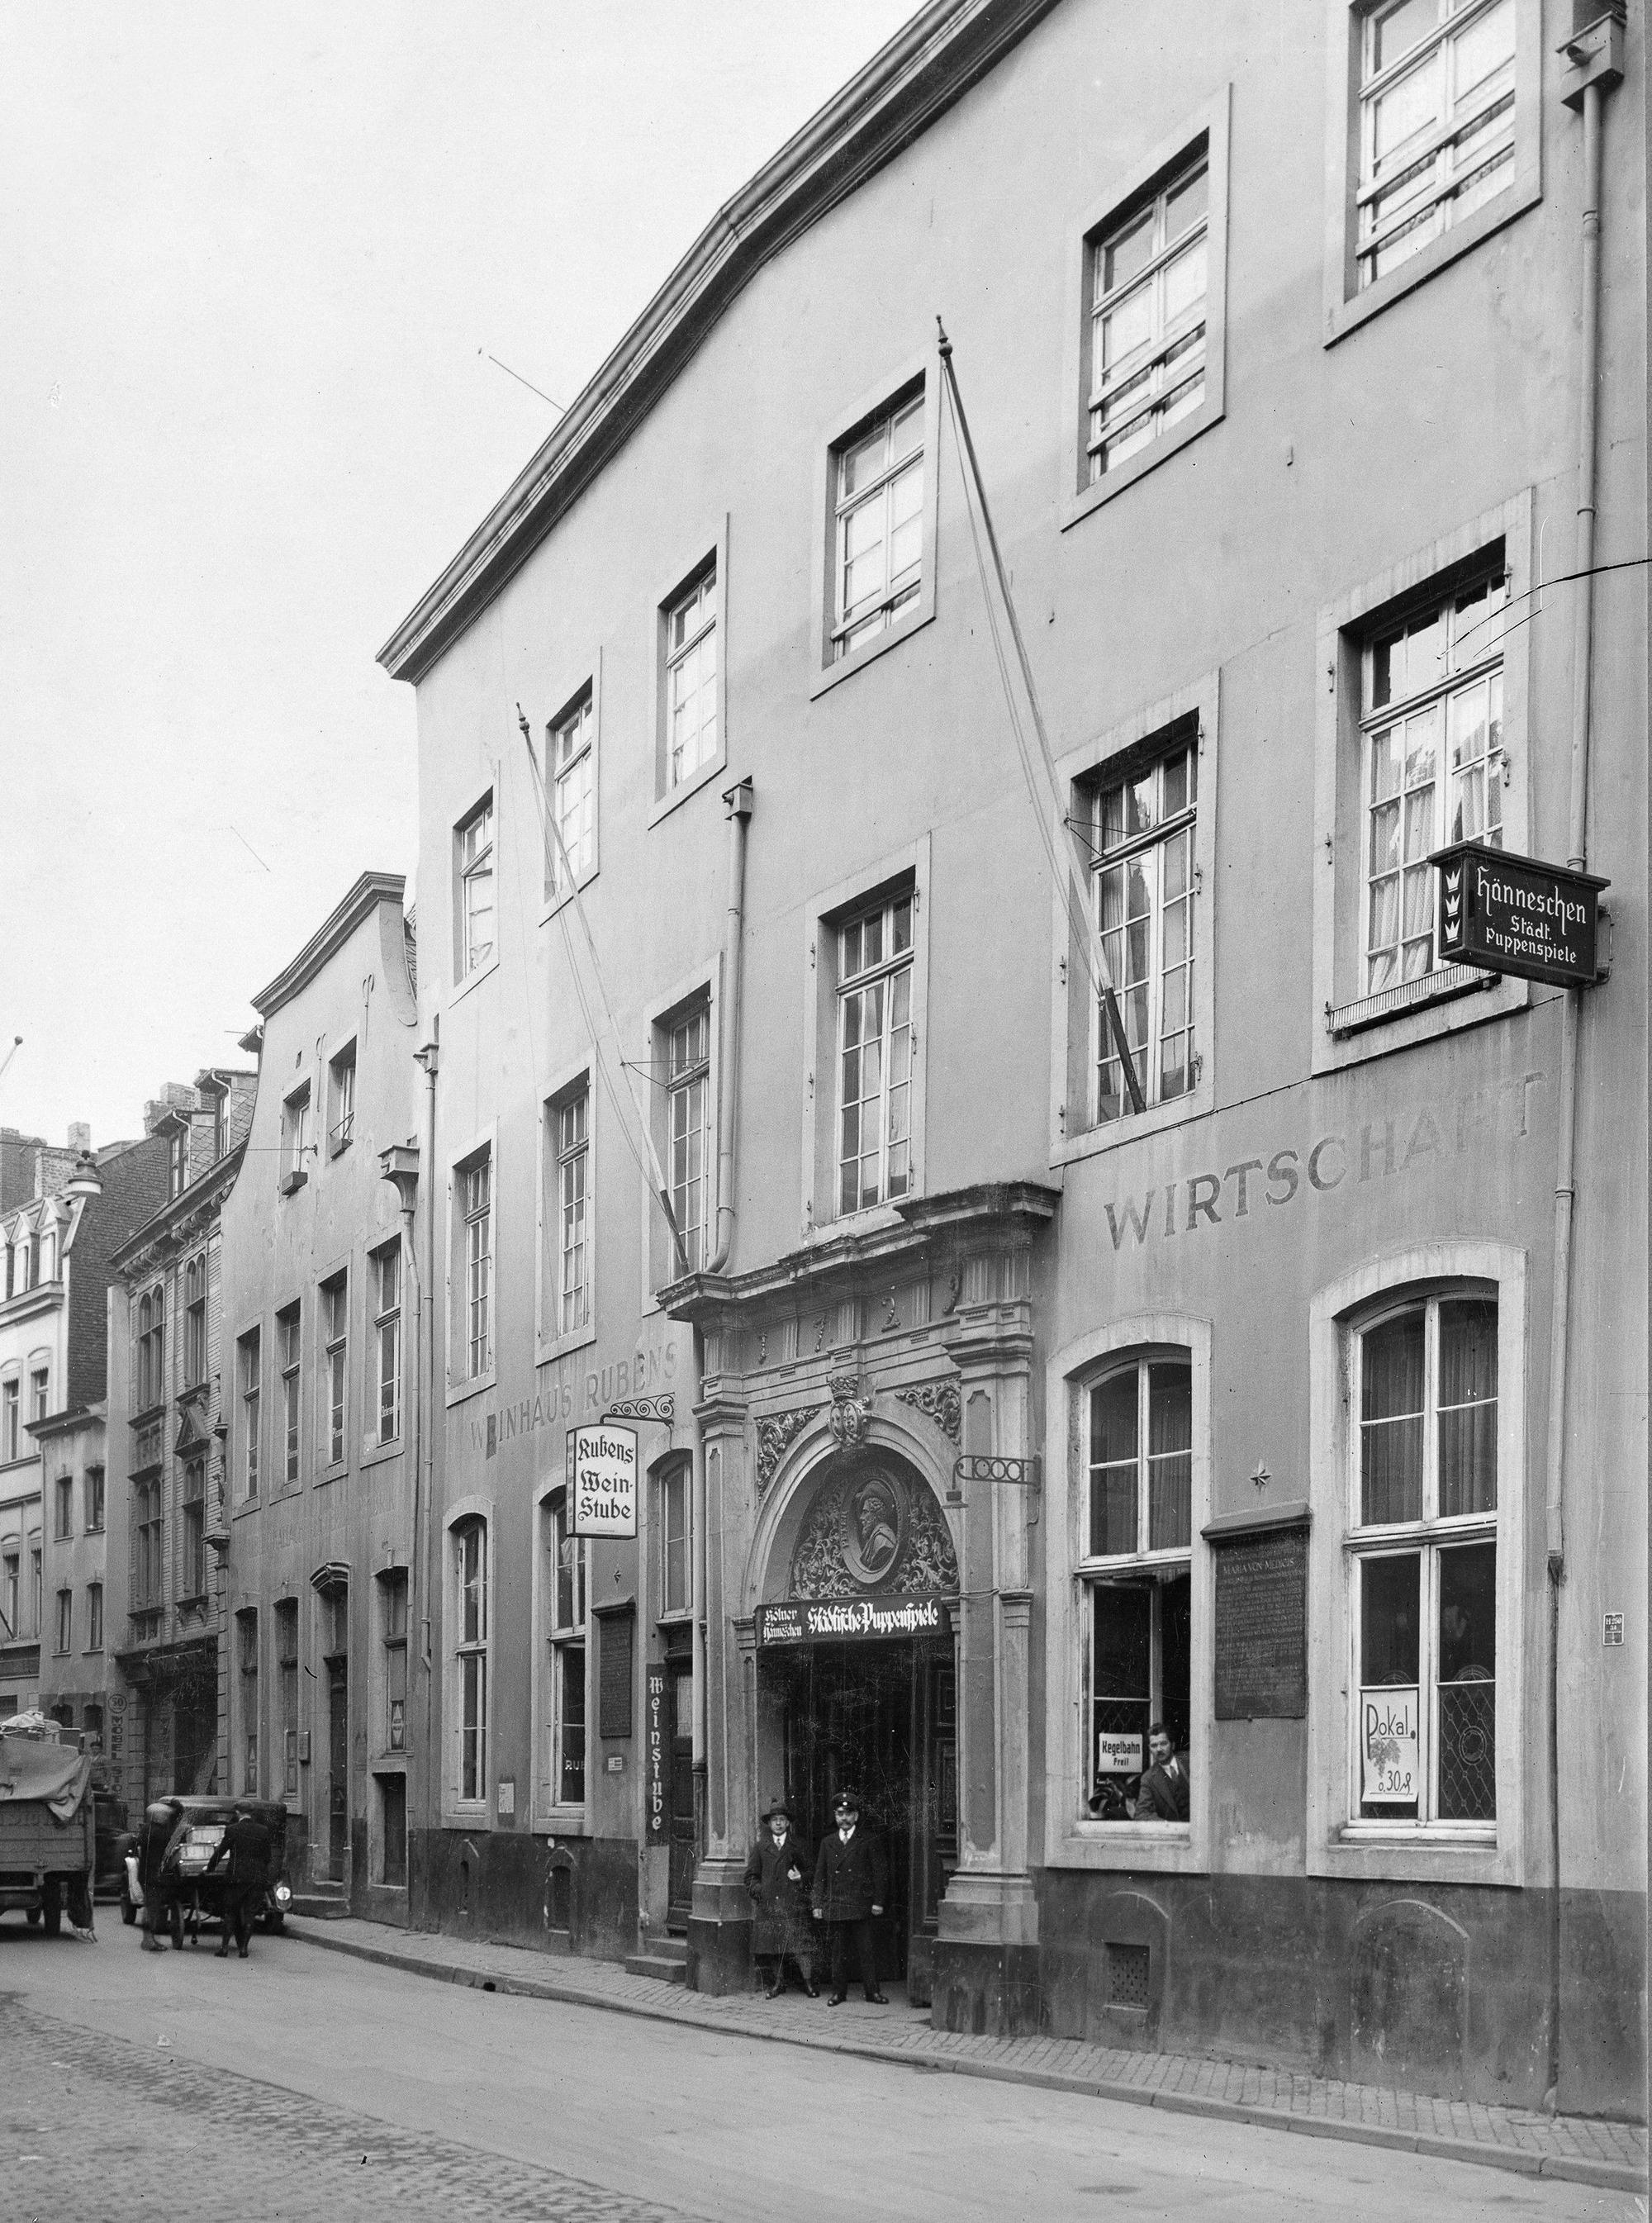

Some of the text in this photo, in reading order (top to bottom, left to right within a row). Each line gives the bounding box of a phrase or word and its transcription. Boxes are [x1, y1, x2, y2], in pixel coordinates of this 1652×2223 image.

[1477, 866, 1586, 935] Hänneschen
[1511, 914, 1552, 940] Städt.
[585, 1341, 678, 1408] RUBENS
[577, 1435, 634, 1464] Rubens
[580, 1469, 633, 1493] Wein-
[578, 1496, 632, 1521] Stube
[649, 1676, 663, 1831] Weinstube
[1102, 1741, 1141, 1756] Kegelbahn
